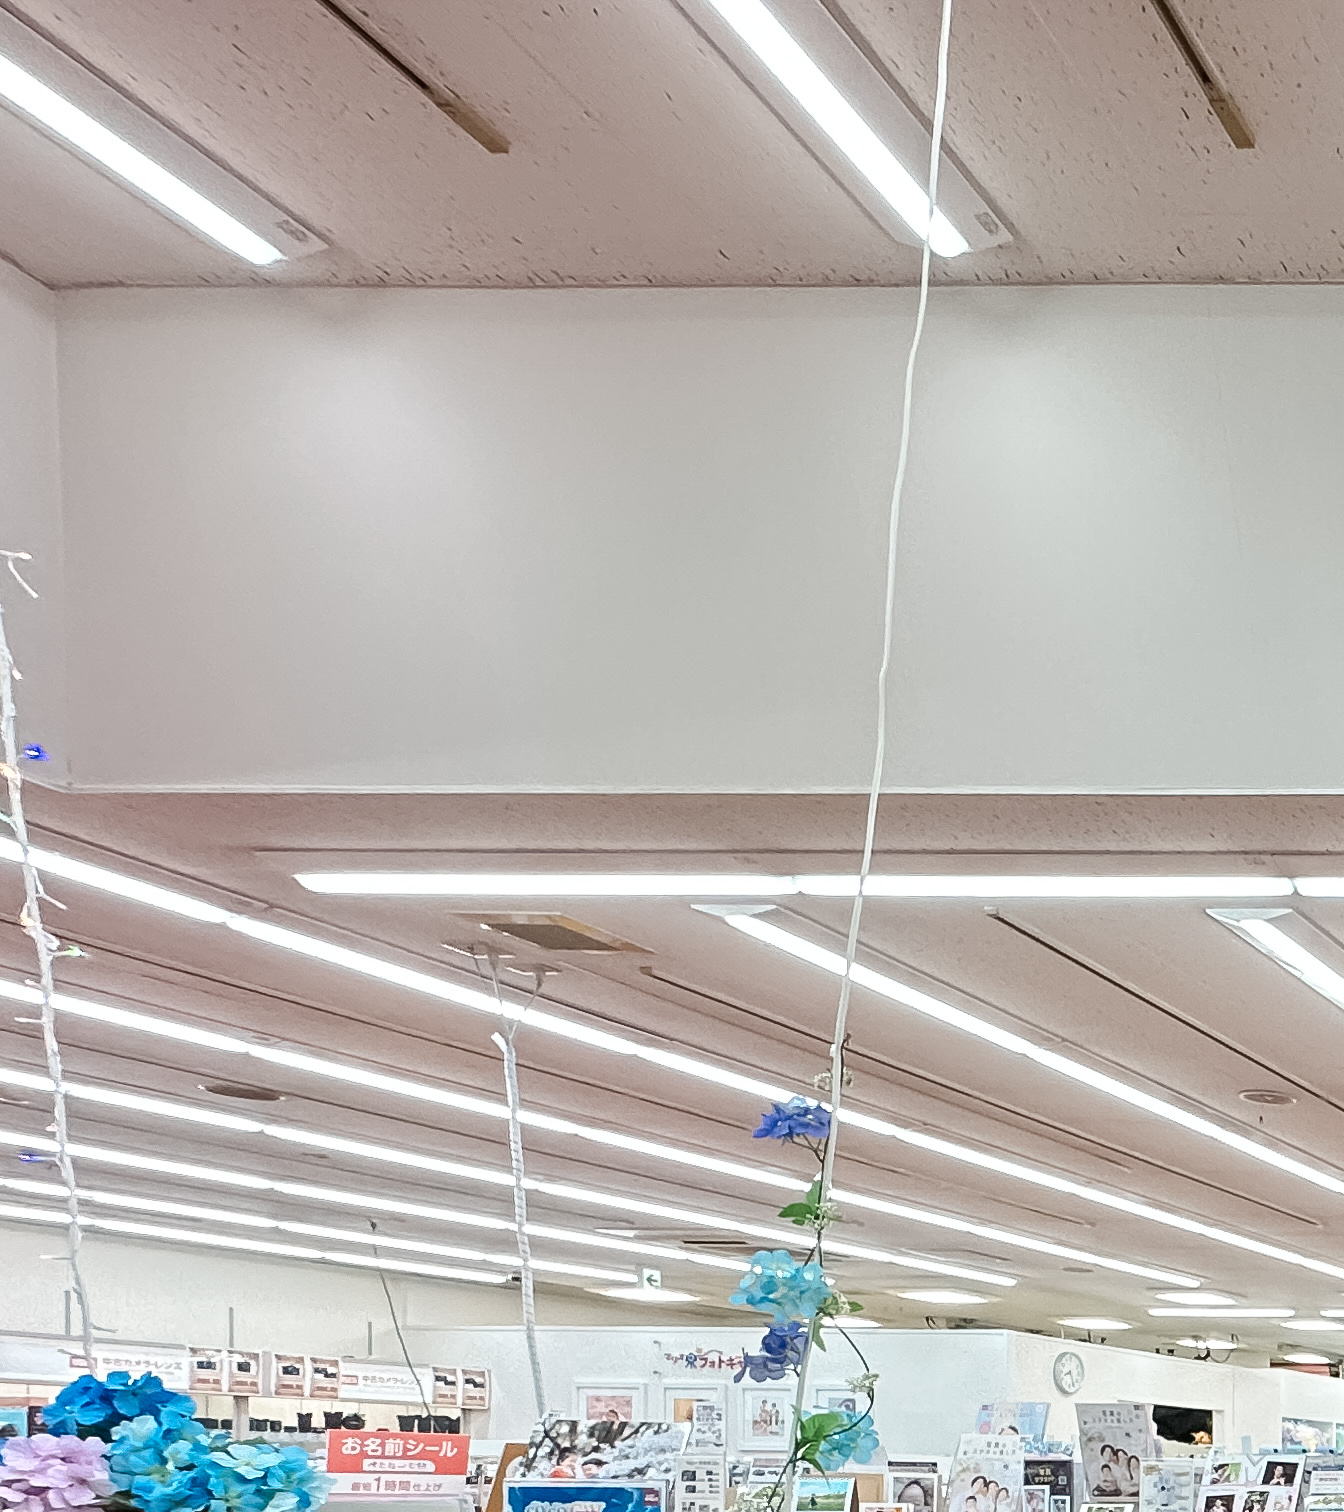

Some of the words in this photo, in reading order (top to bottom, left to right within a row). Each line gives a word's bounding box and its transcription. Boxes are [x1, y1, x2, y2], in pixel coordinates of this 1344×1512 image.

[341, 1436, 457, 1457] お名前シール
